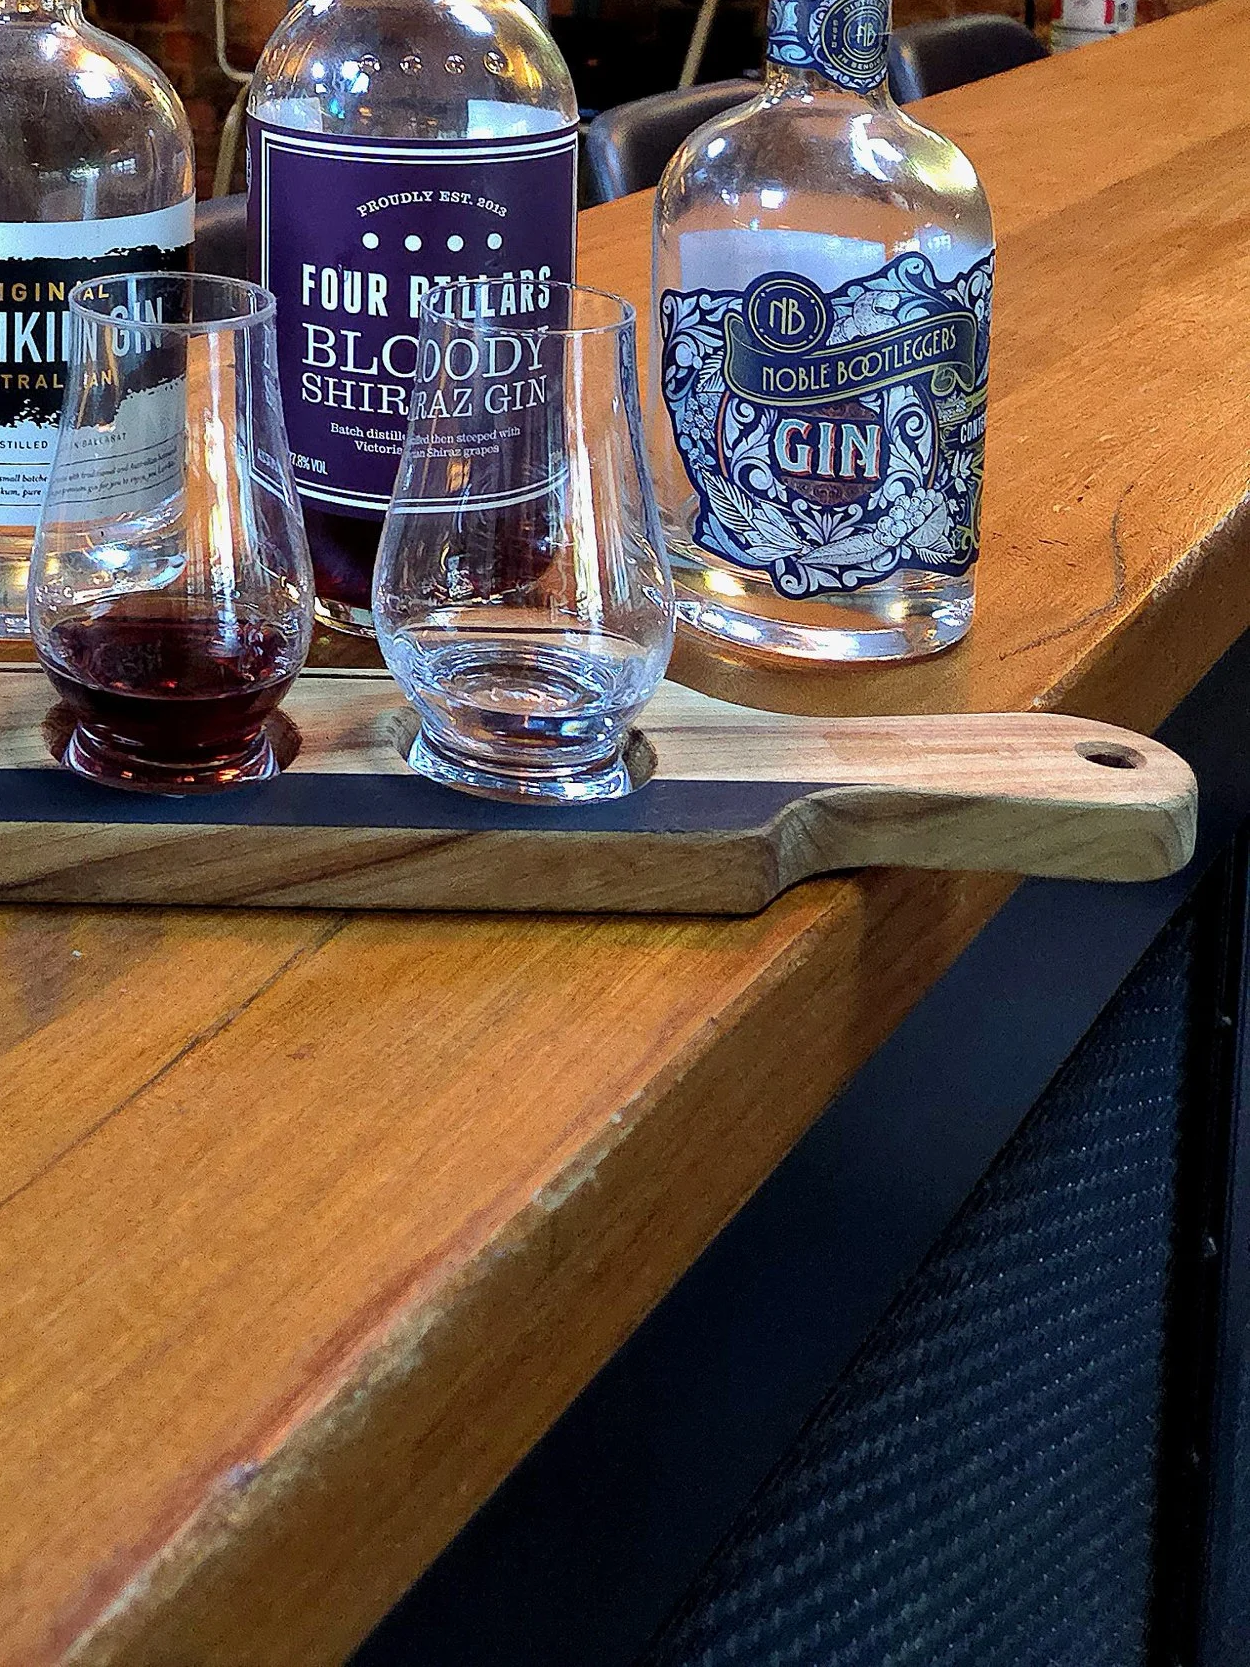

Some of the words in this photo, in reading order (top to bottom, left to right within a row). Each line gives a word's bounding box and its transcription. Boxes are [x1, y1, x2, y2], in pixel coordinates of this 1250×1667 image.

[356, 190, 433, 217] PROUDLY
[438, 190, 473, 206] EST.
[476, 195, 508, 218] 2013
[302, 263, 388, 318] FOUR
[409, 265, 552, 319] PILLARS
[110, 297, 163, 357] GIN
[301, 322, 550, 383] BLOODY
[762, 360, 831, 392] NOBLE
[836, 326, 958, 390] BOOTLEGGERS
[301, 372, 473, 422] SHIRAZ
[484, 374, 548, 415] GIN
[330, 422, 364, 438] Batch
[431, 432, 455, 445] then
[498, 425, 522, 439] with
[427, 446, 463, 458] Shiraz
[773, 418, 881, 482] GIN
[21, 475, 48, 484] batche
[311, 457, 329, 476] VOL
[21, 487, 43, 499] pure
